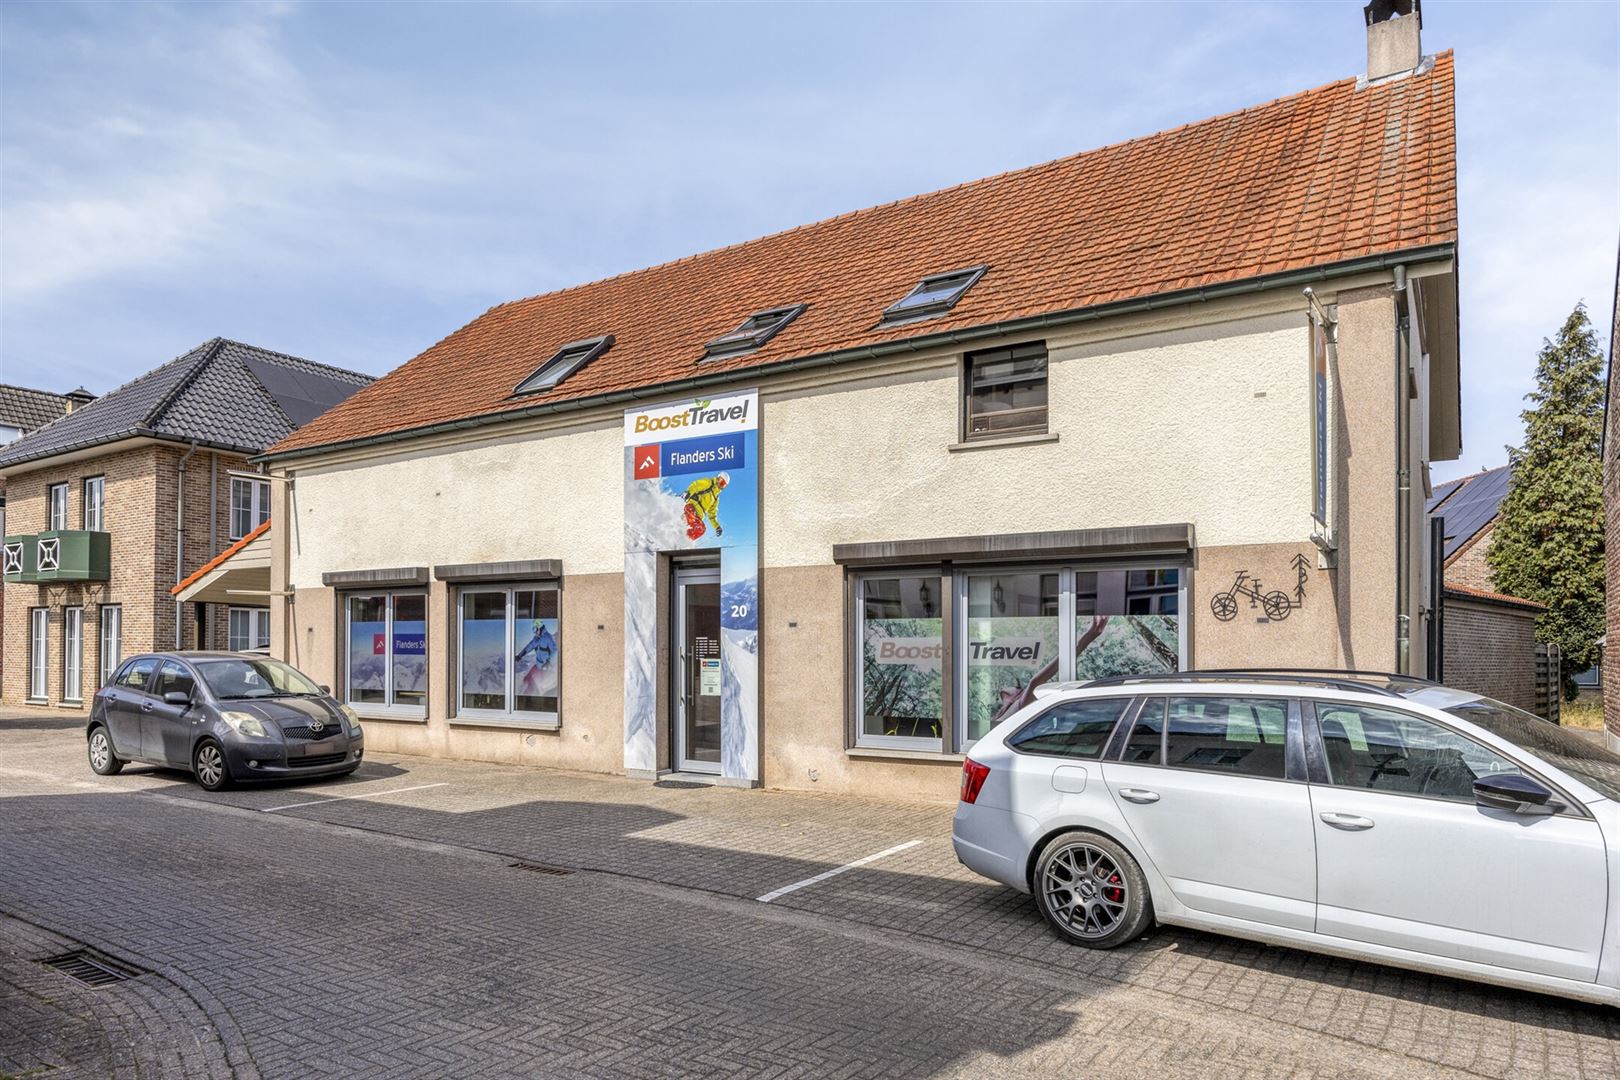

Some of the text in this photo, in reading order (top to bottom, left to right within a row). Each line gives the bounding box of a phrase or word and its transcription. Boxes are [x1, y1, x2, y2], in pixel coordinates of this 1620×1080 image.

[671, 445, 735, 466] Flanders Ski
[731, 604, 748, 618] 20
[880, 641, 1041, 660] Boost Travel
